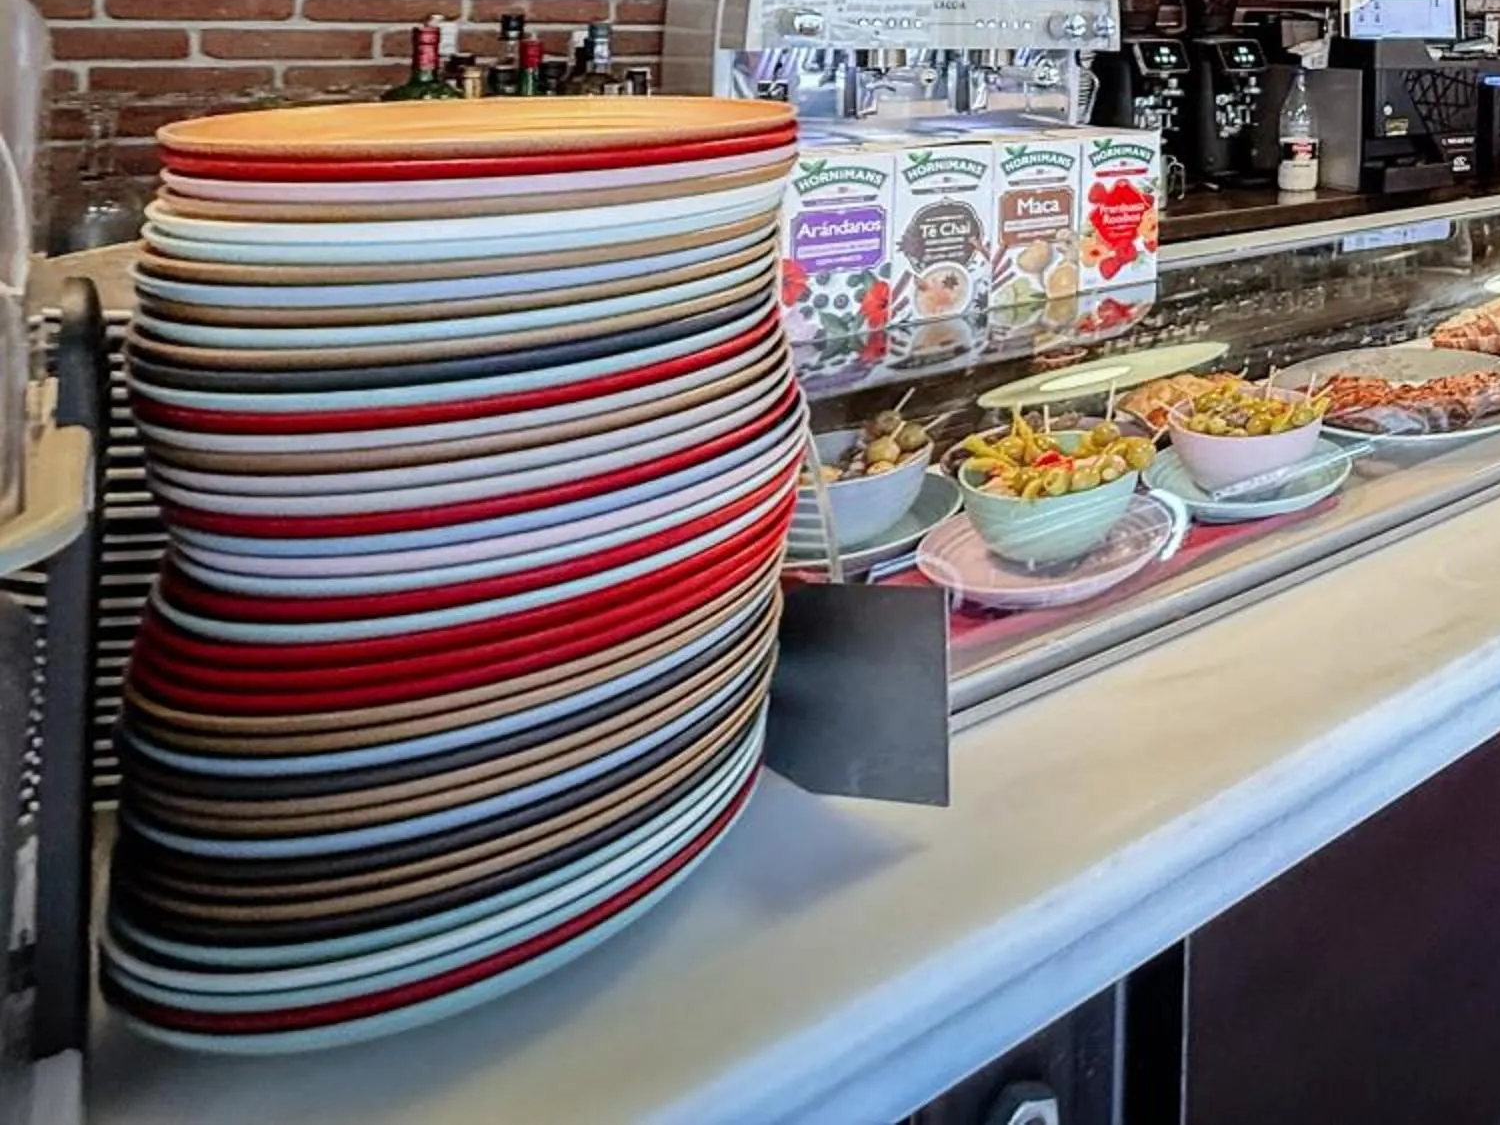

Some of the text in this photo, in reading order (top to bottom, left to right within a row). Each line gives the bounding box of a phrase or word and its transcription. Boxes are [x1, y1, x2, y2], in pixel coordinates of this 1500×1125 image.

[1004, 152, 1073, 173] HORNIMANS
[1091, 144, 1151, 165] HORNIMANS
[799, 168, 884, 190] HORNIMANS
[907, 158, 983, 179] HORNIMANS
[1017, 197, 1061, 216] Maca
[797, 219, 881, 240] Arándanos
[939, 220, 972, 236] Chai
